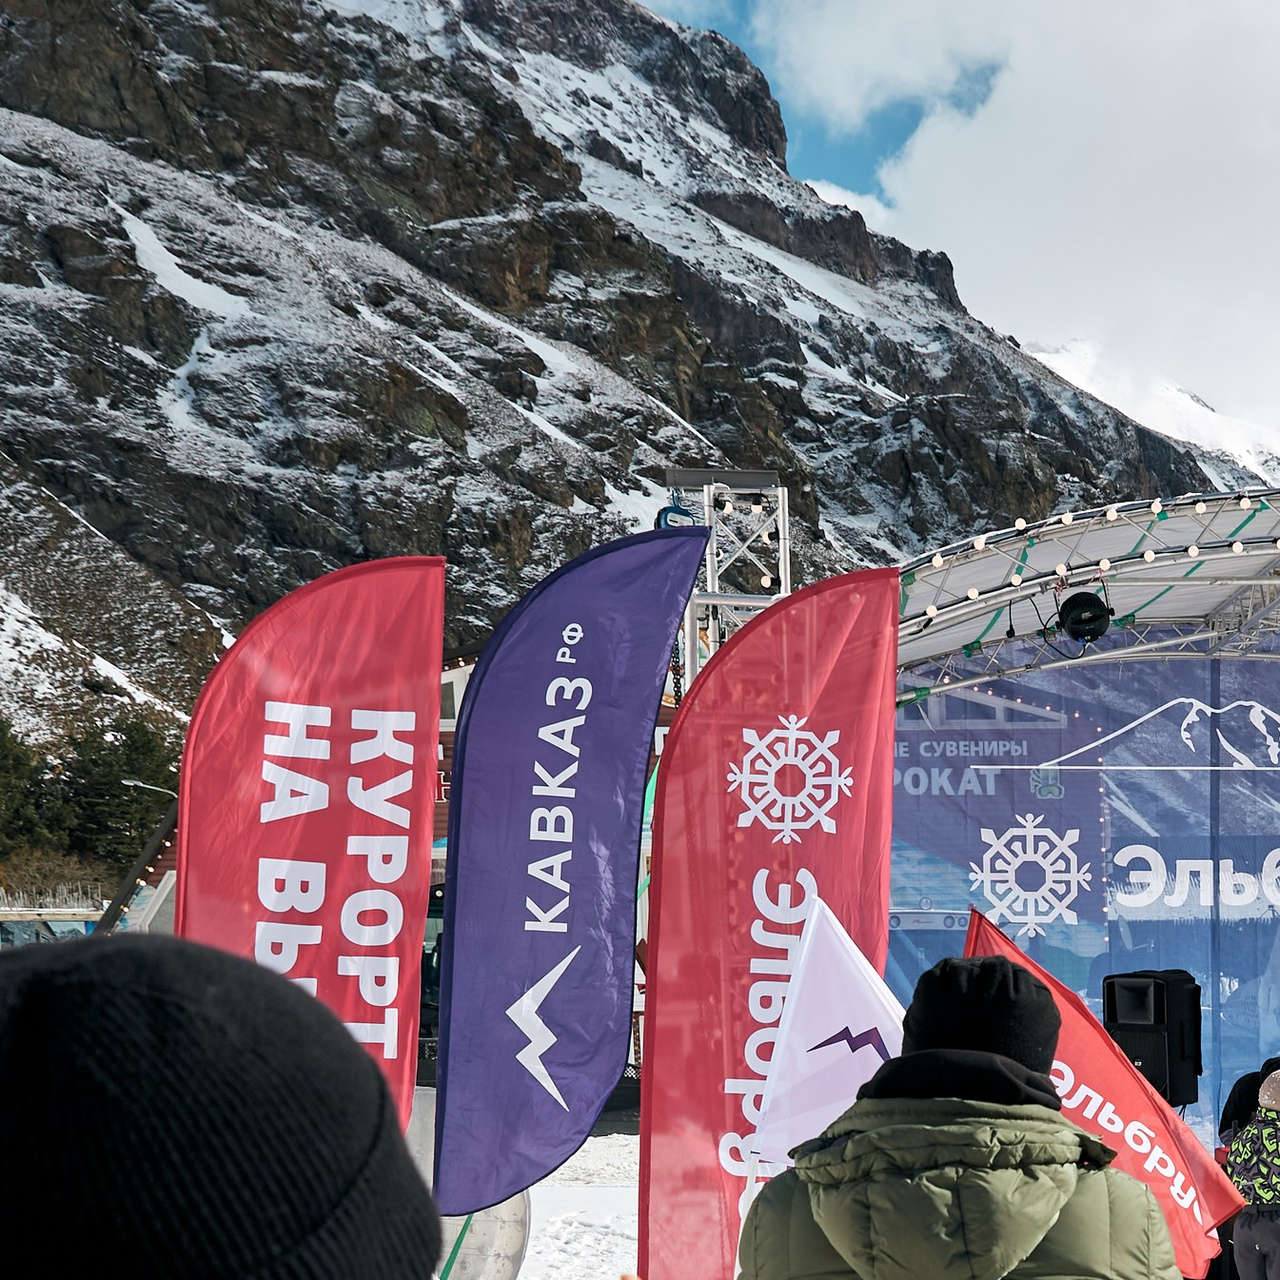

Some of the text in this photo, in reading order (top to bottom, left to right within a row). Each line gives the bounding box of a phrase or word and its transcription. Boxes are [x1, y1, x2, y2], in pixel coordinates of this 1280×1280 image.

[260, 701, 331, 823] НА
[524, 622, 593, 933] КАВКАЗ РФ
[919, 740, 1028, 757] СУВЕНИРЫ
[337, 709, 416, 1059] КУРОРТ
